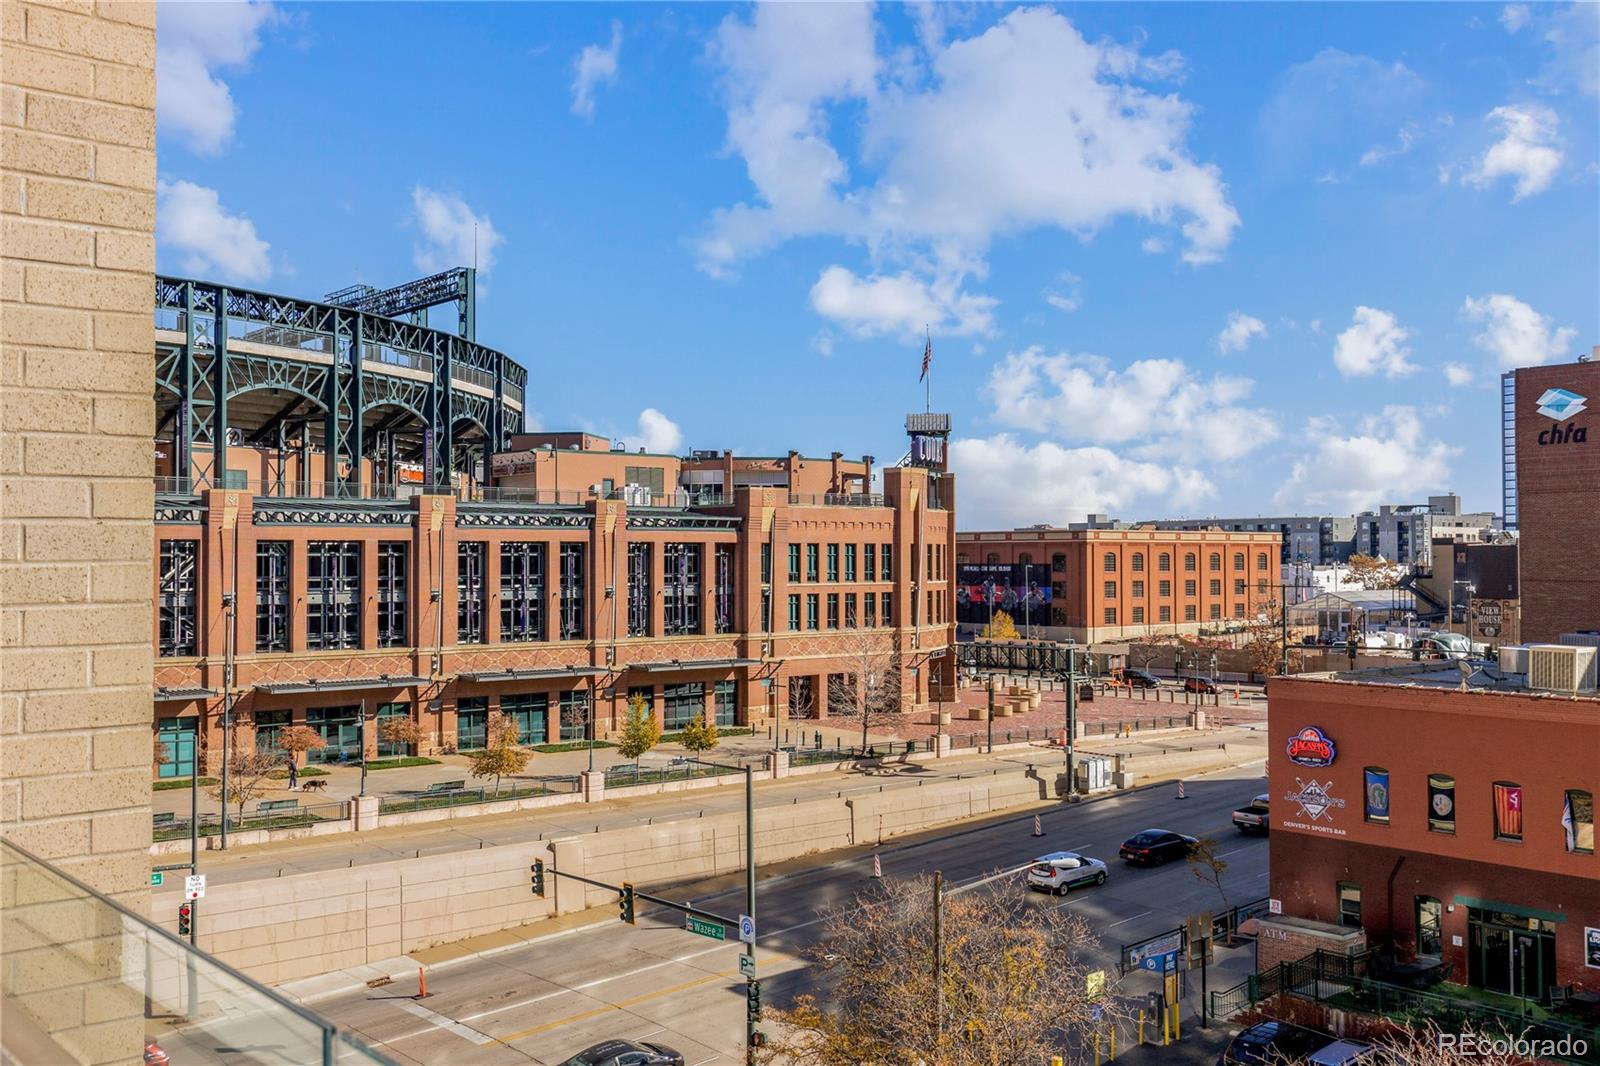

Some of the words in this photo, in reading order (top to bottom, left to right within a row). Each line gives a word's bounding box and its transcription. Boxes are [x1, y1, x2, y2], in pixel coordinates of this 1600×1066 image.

[1537, 422, 1587, 446] chfa
[1481, 606, 1500, 615] VIEW
[1479, 615, 1503, 625] HOUSE
[1283, 821, 1310, 830] DENVER'S
[1311, 825, 1333, 834] SPORTS
[694, 922, 716, 937] Wazee
[1264, 928, 1287, 940] ATM
[741, 957, 748, 971] P
